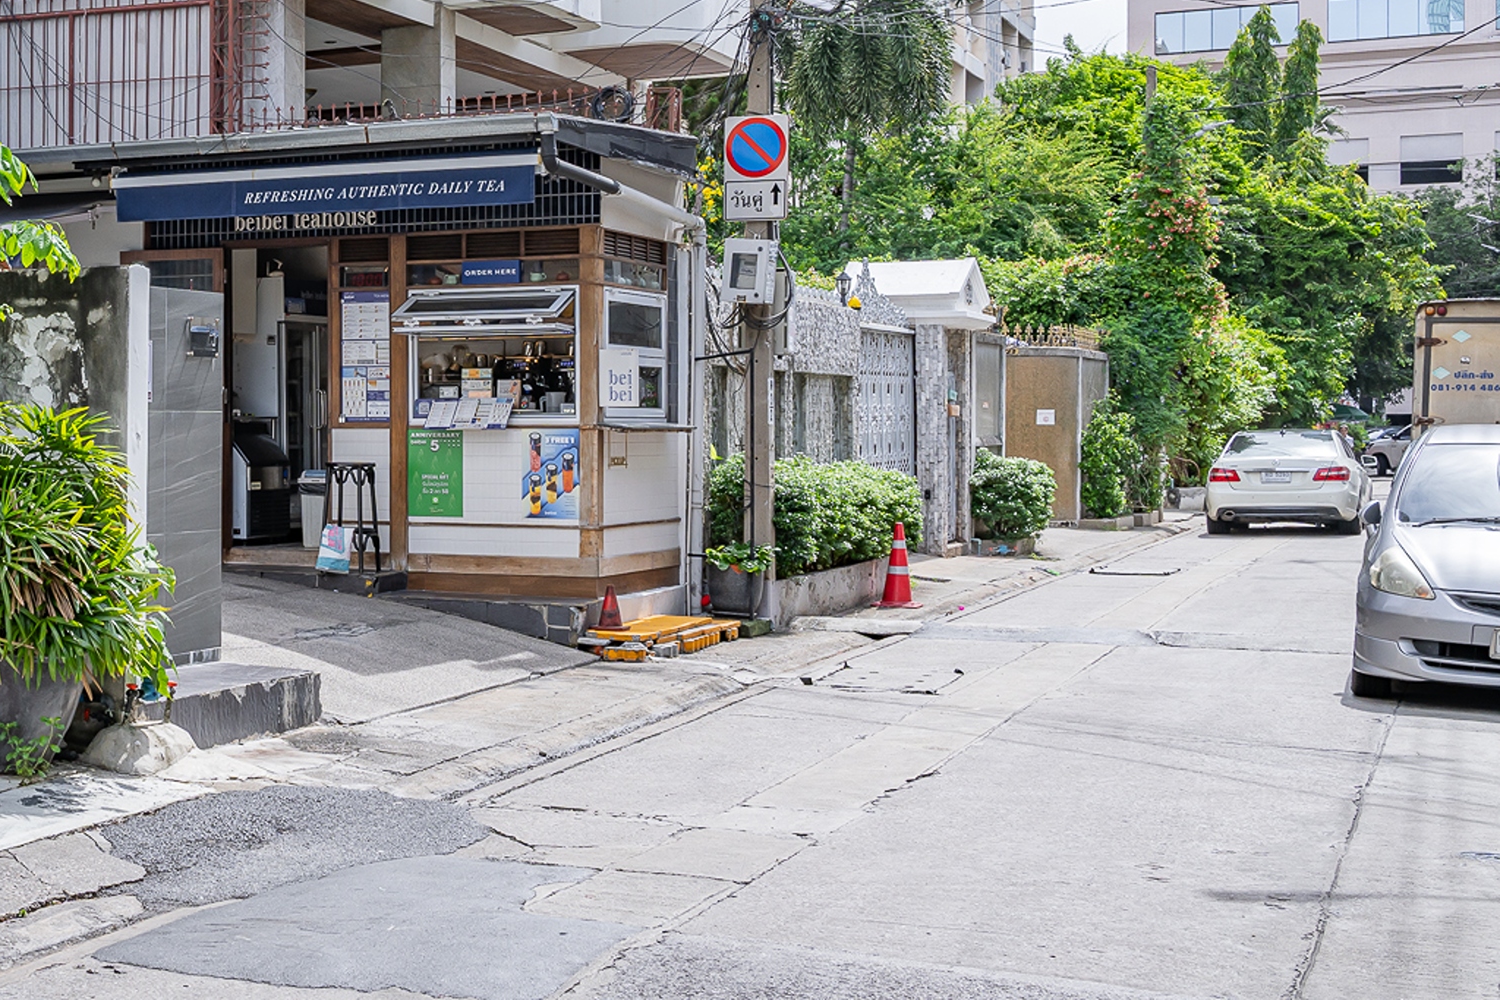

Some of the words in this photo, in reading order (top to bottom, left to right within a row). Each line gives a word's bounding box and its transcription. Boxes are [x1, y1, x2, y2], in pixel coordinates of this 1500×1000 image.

[244, 188, 334, 204] REFRESHING
[337, 183, 424, 199] AUTHENTIC
[427, 180, 473, 195] DAILY
[476, 179, 506, 193] TEA
[731, 190, 763, 213] วันคู่
[464, 269, 493, 277] ORDER
[495, 268, 517, 276] HERE
[609, 369, 632, 385] bei
[609, 385, 632, 401] bei
[430, 440, 440, 452] 5
